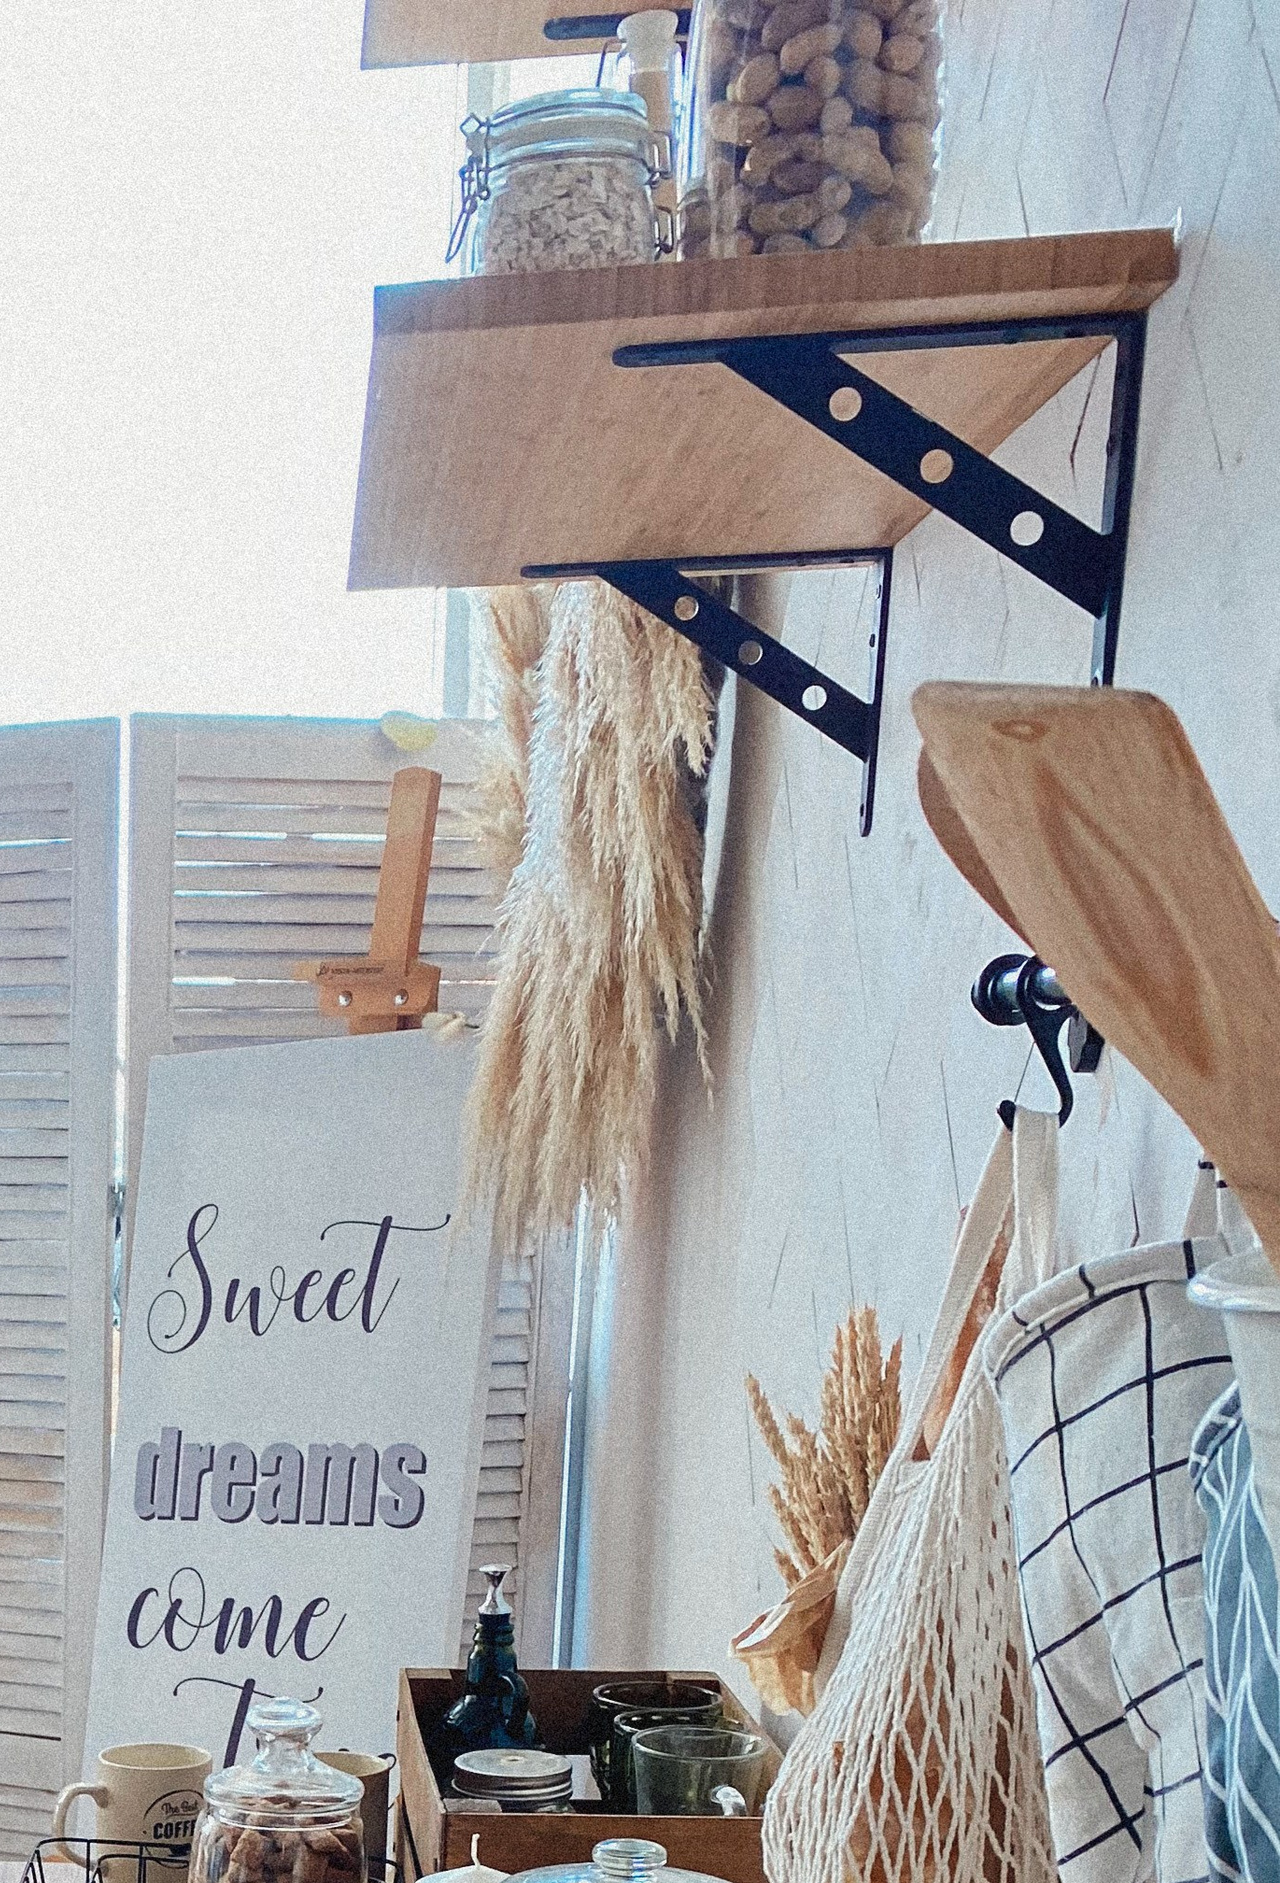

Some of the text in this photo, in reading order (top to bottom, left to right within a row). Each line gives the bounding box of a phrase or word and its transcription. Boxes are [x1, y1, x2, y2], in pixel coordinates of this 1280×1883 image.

[147, 1203, 451, 1353] Sweet
[133, 1427, 427, 1529] dreams
[126, 1567, 346, 1661] come
